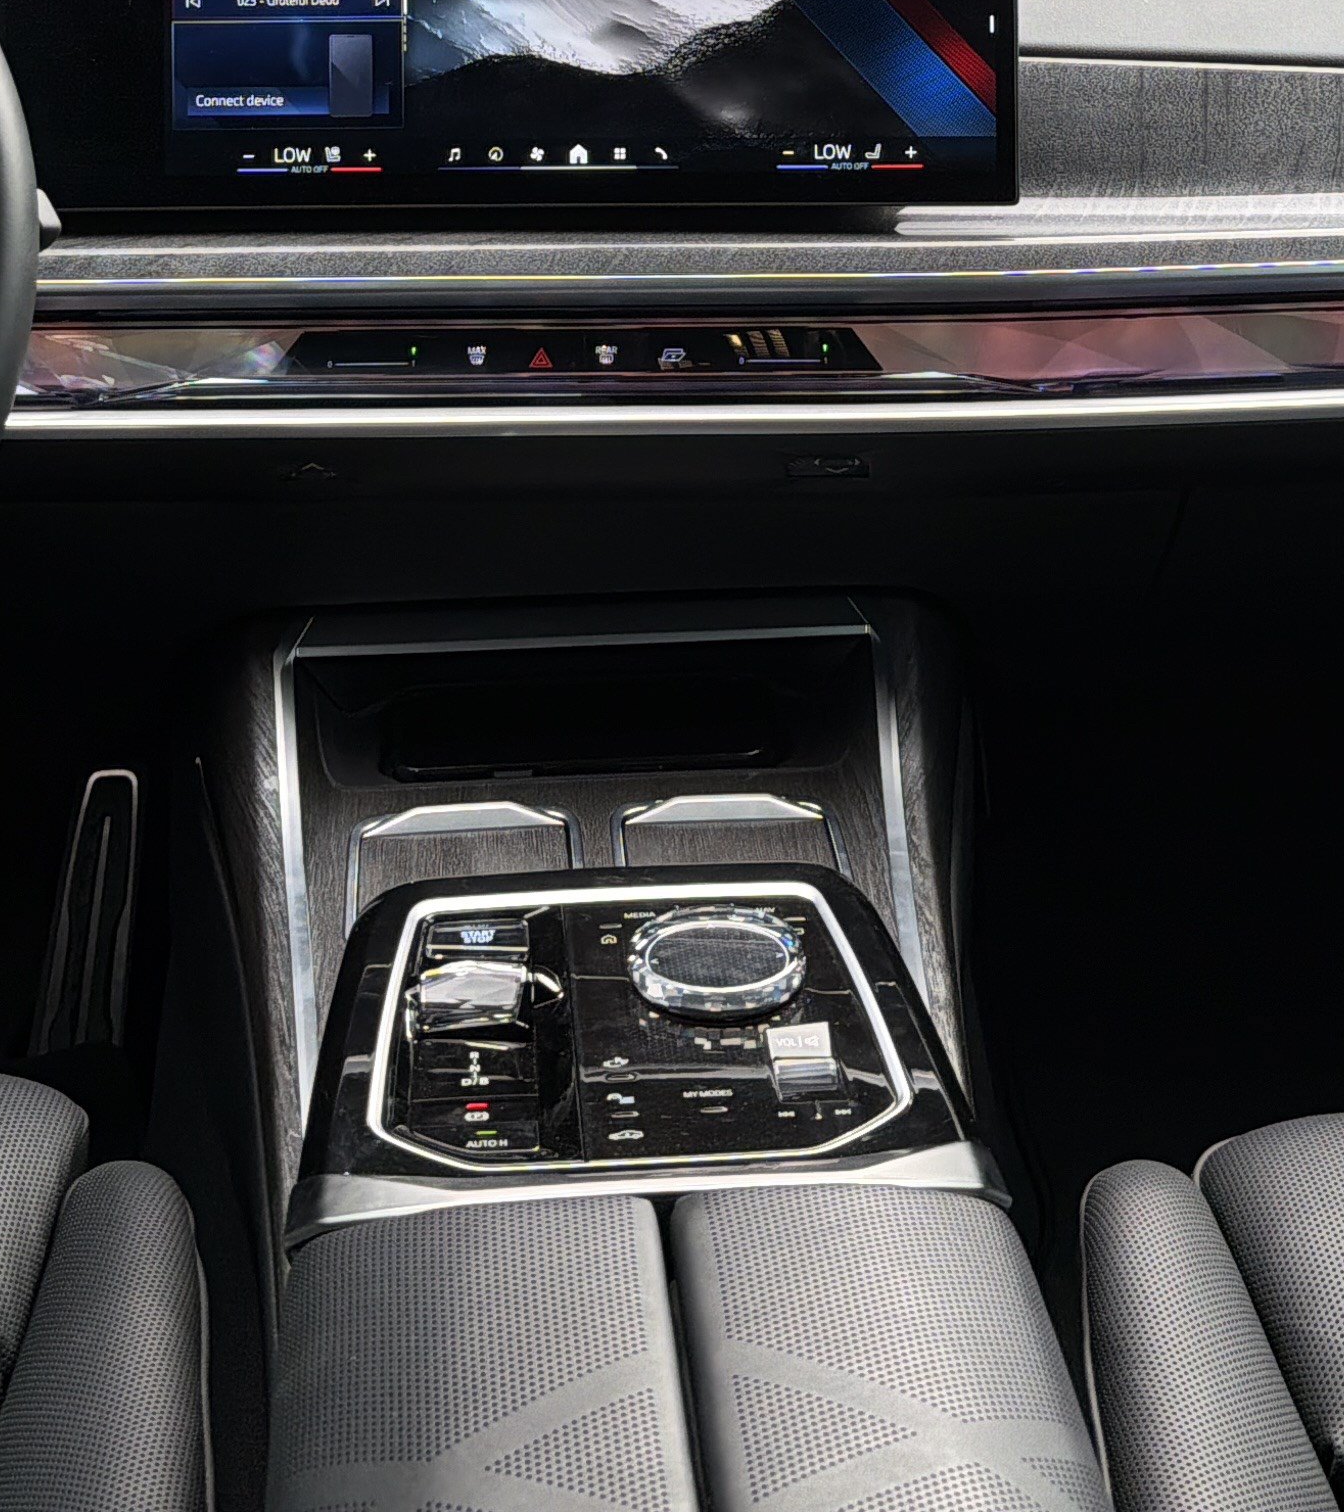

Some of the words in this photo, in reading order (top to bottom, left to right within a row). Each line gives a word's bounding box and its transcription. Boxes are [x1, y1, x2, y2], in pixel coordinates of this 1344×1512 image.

[195, 94, 244, 107] Connect
[246, 94, 284, 107] device
[274, 147, 312, 163] LOW
[814, 144, 852, 160] LOW
[291, 165, 312, 173] AUTO
[831, 162, 853, 170] AUTO
[467, 345, 486, 354] MAX
[595, 345, 618, 355] REAR
[623, 911, 656, 920] MEDIA
[460, 929, 496, 939] START
[775, 1036, 797, 1048] VOL
[469, 1064, 481, 1073] N
[682, 1090, 698, 1098] MY
[699, 1088, 734, 1098] MODES
[466, 1139, 498, 1148] AUTO
[498, 1138, 509, 1147] H
